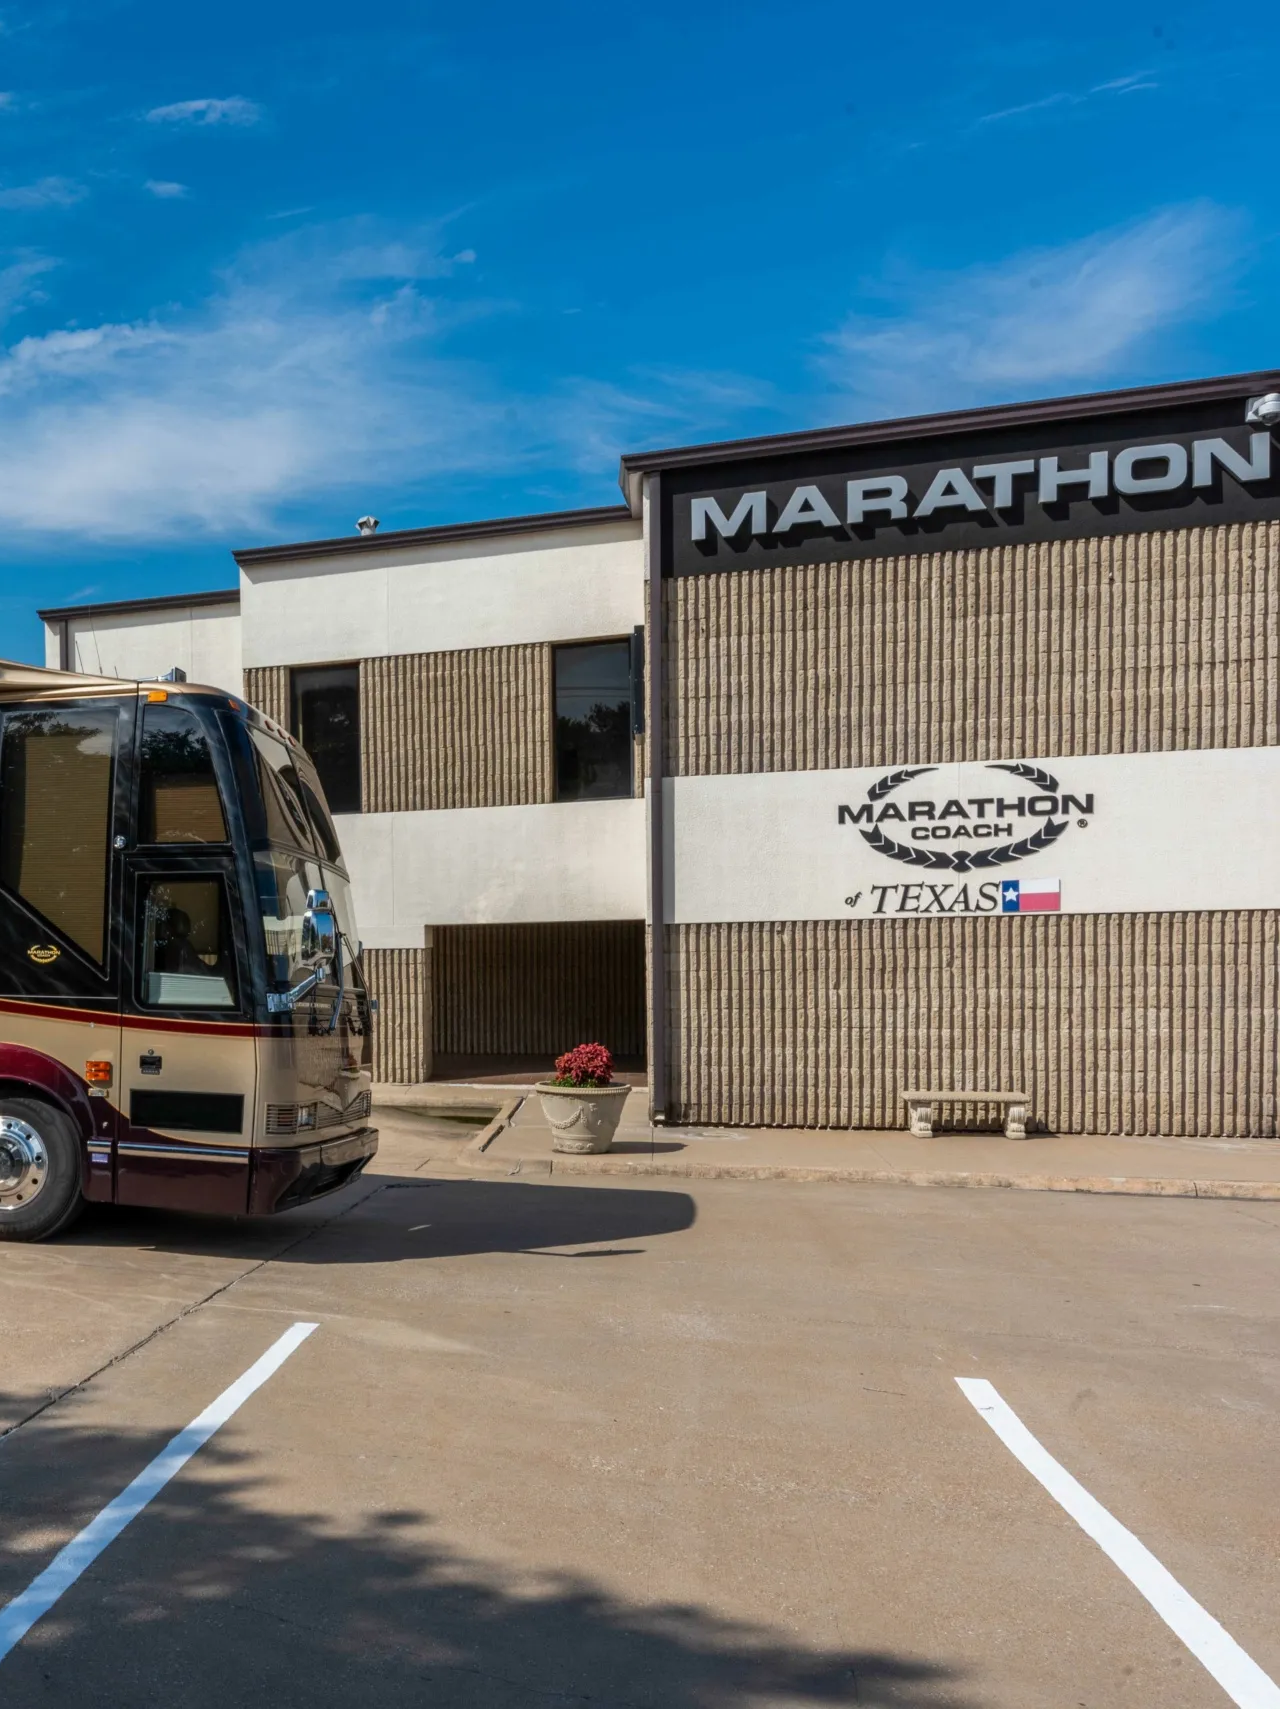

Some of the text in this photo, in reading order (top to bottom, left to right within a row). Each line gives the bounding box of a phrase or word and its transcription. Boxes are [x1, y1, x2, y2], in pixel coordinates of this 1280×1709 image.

[690, 432, 1271, 542] MARATHON
[838, 793, 1095, 825] MARATHON
[911, 823, 1013, 841] COACH
[844, 881, 1001, 914] of TEXAS
